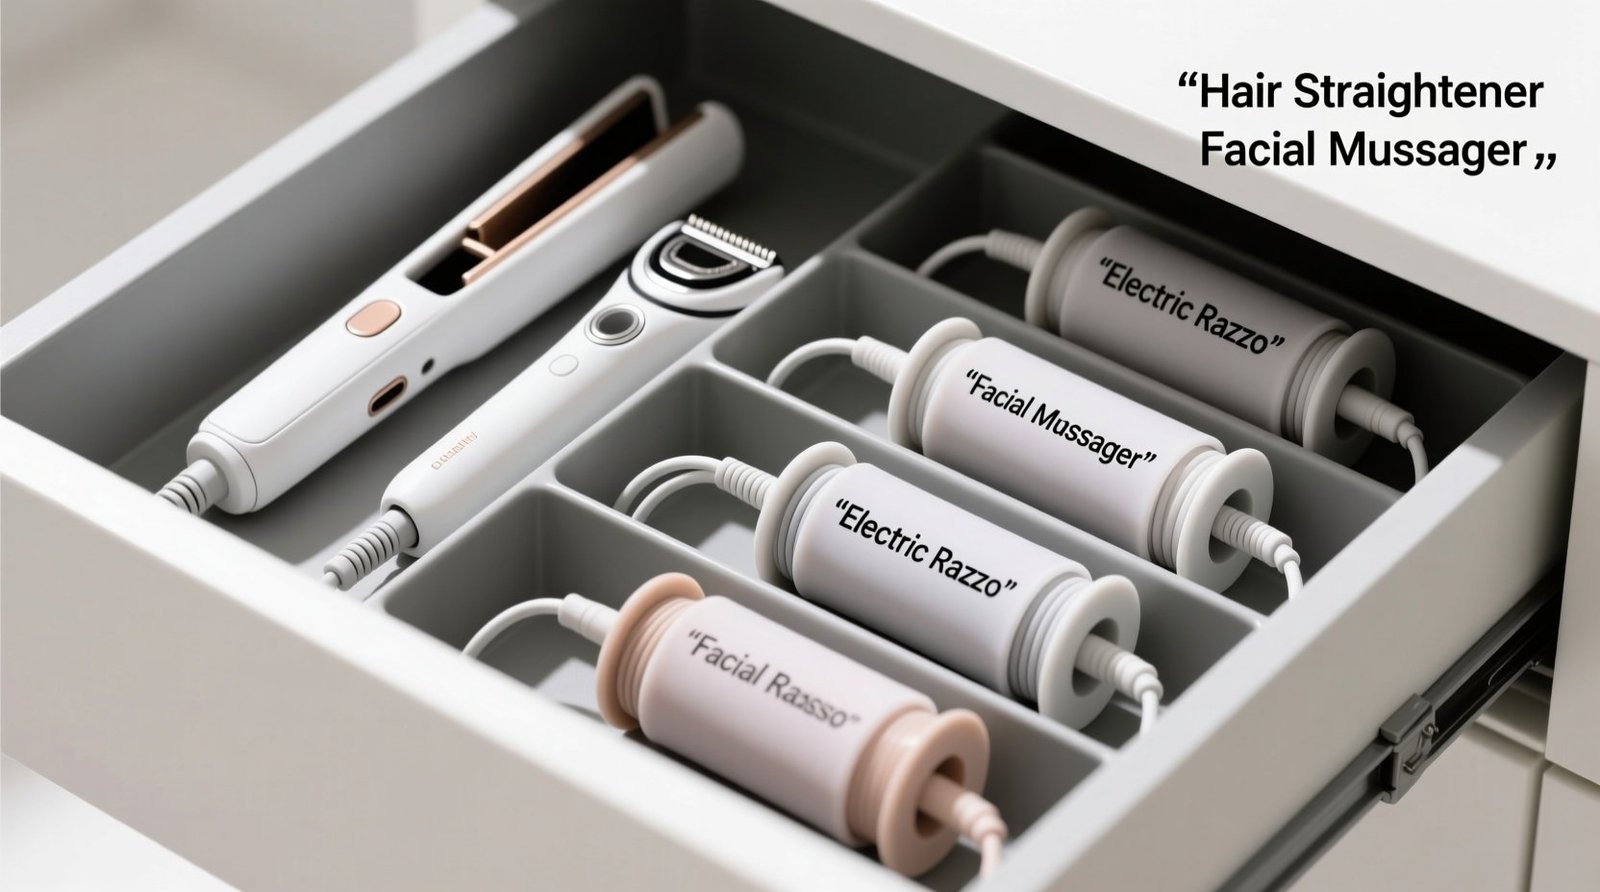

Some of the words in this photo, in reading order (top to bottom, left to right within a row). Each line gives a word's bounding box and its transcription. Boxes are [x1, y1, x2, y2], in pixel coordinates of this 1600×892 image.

[1100, 256, 1194, 320] “Electric
[1194, 303, 1285, 354] Razzo”
[966, 369, 1035, 418] “Facial
[1031, 403, 1157, 469] Mussager”
[835, 498, 929, 562] “Electric
[929, 546, 1018, 598] Razzo”
[688, 629, 770, 686] “Facial
